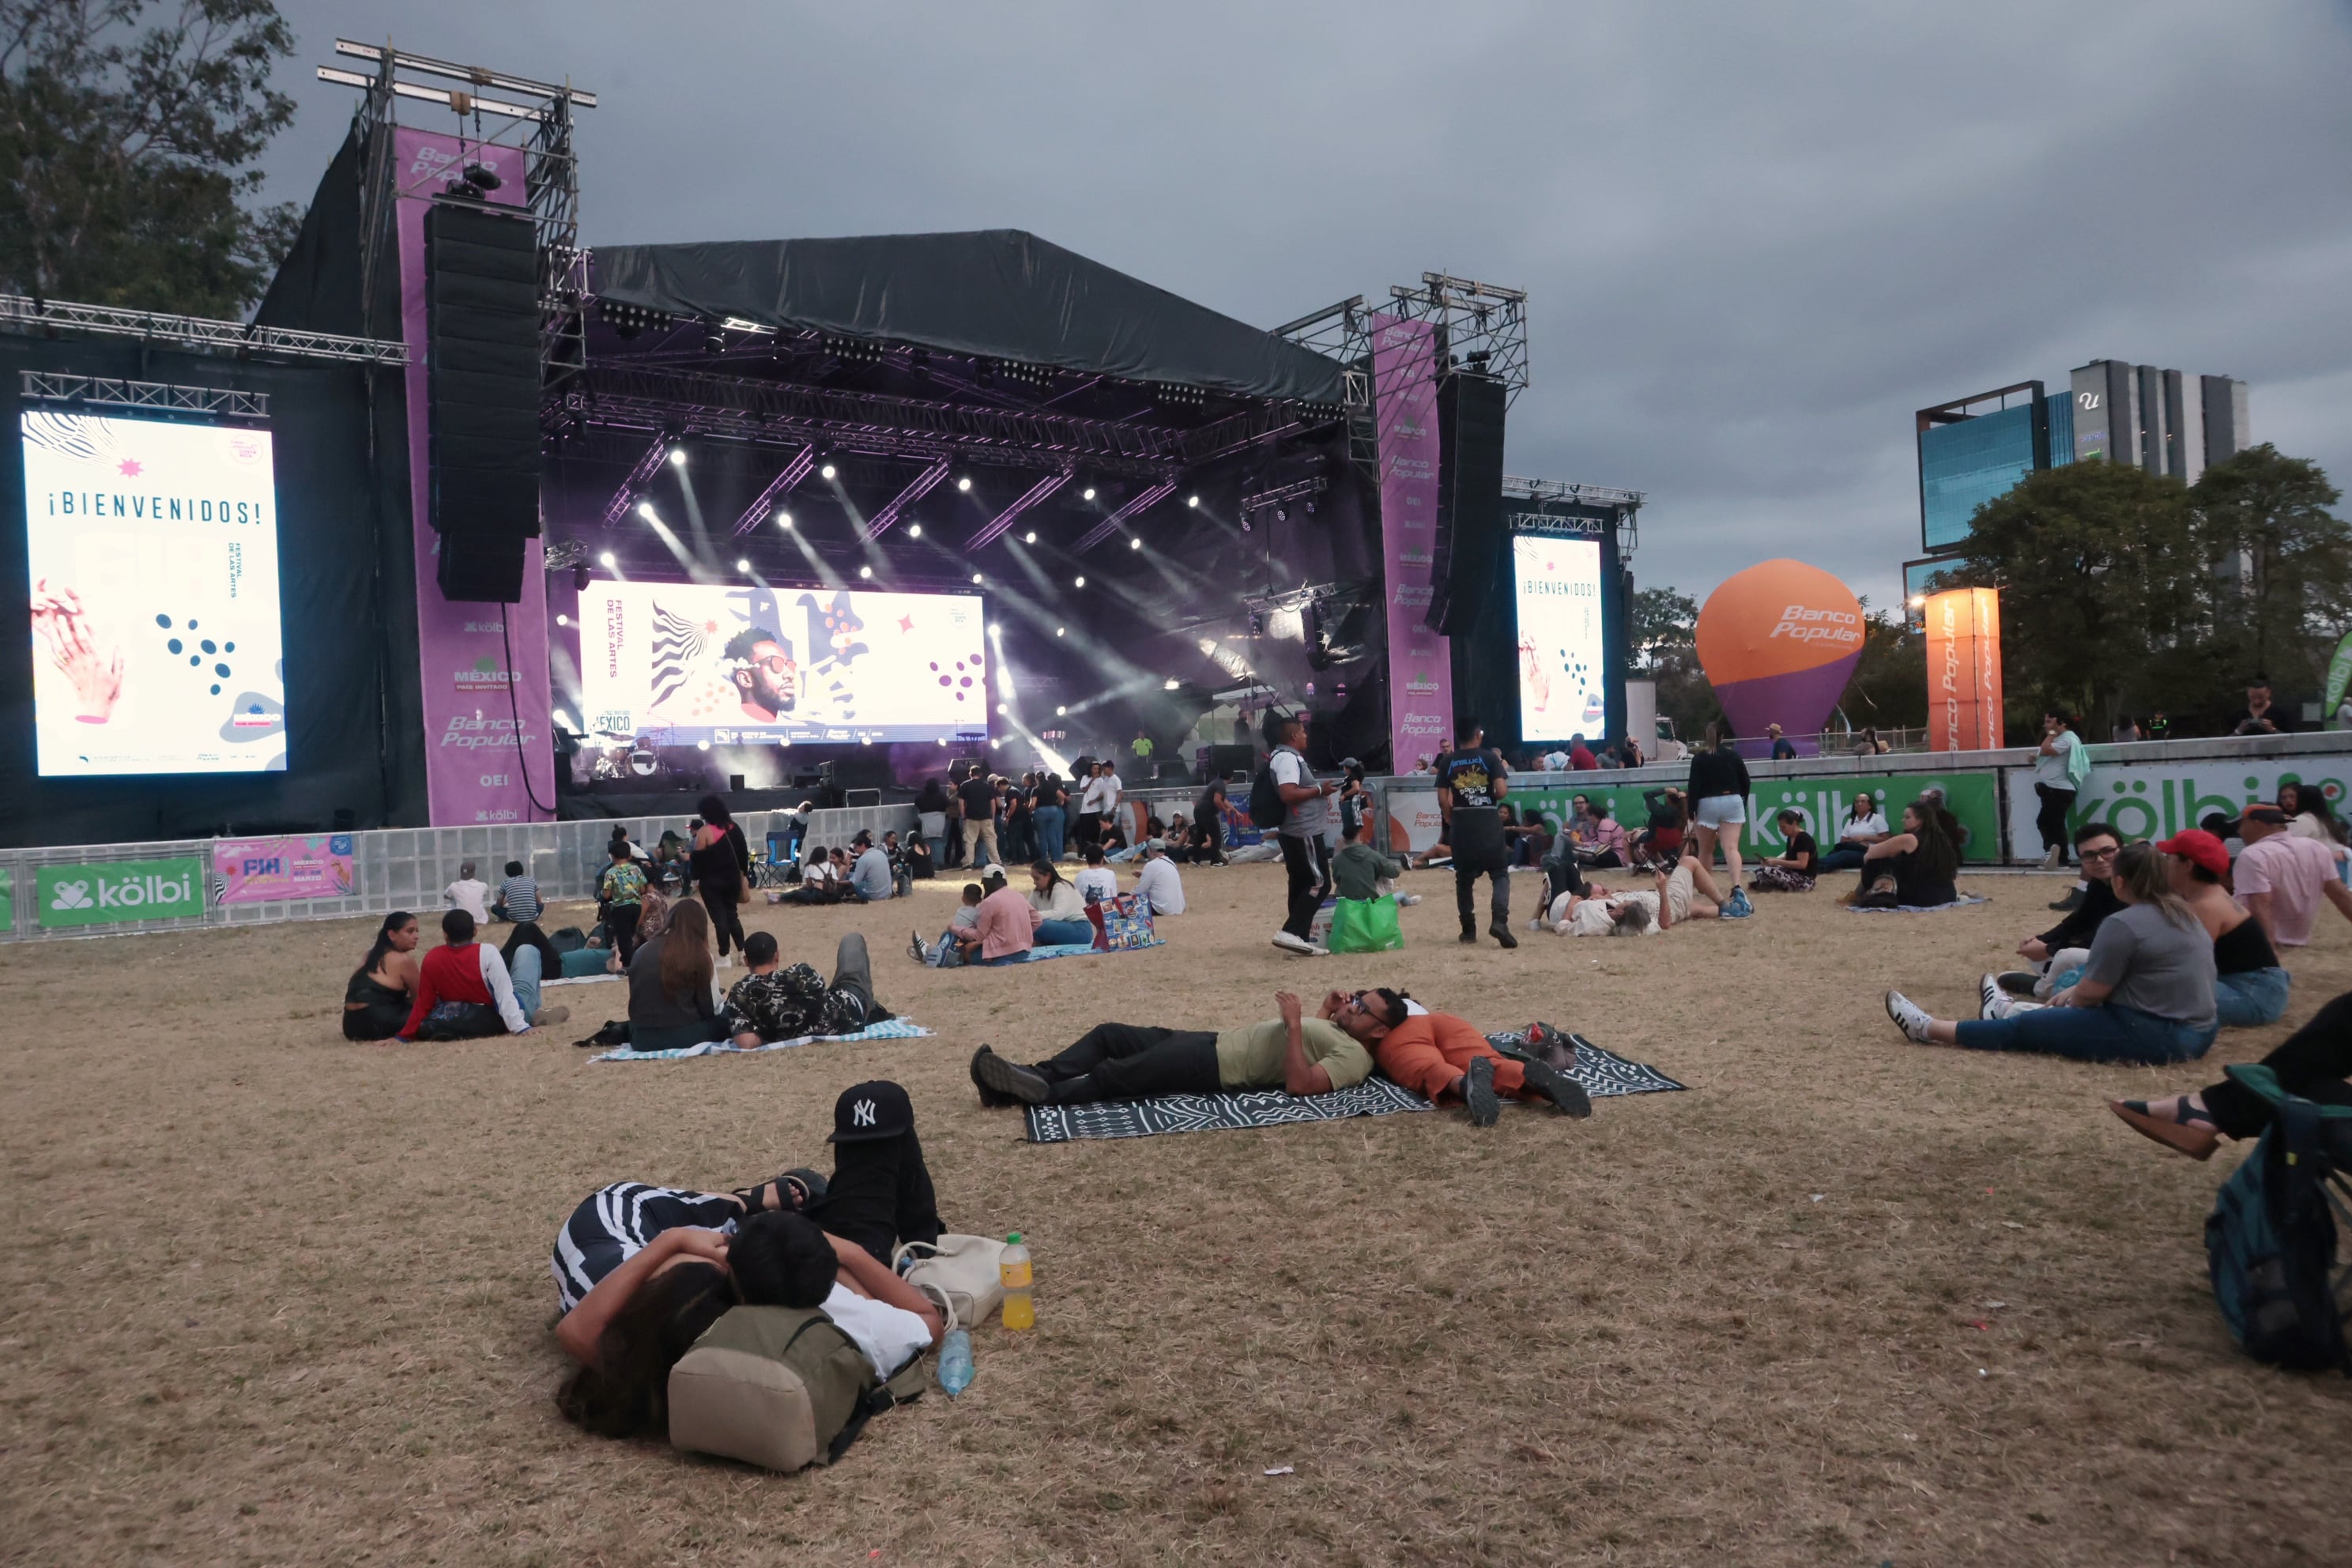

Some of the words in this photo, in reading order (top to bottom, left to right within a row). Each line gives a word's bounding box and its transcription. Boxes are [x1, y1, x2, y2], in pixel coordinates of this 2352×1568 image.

[49, 492, 261, 524] ¡BIENVENIDOS!
[228, 543, 234, 553] DE
[1523, 580, 1596, 597] ¡BIENVENIDOS!
[607, 600, 614, 614] DE
[1781, 605, 1856, 625] Banco
[1770, 621, 1860, 643] Popular
[1943, 598, 1959, 692] Popular
[1982, 597, 1992, 691] Popular
[609, 643, 617, 677] ARTES
[454, 669, 522, 682] MÉXICO
[447, 716, 526, 730] Banco
[1404, 713, 1442, 723] Banco
[1947, 699, 1958, 752] anco
[1400, 723, 1446, 737] Popular
[440, 732, 536, 750] Popular
[480, 775, 508, 786] OEI
[490, 810, 518, 821] kölbi
[98, 873, 190, 907] kölbi
